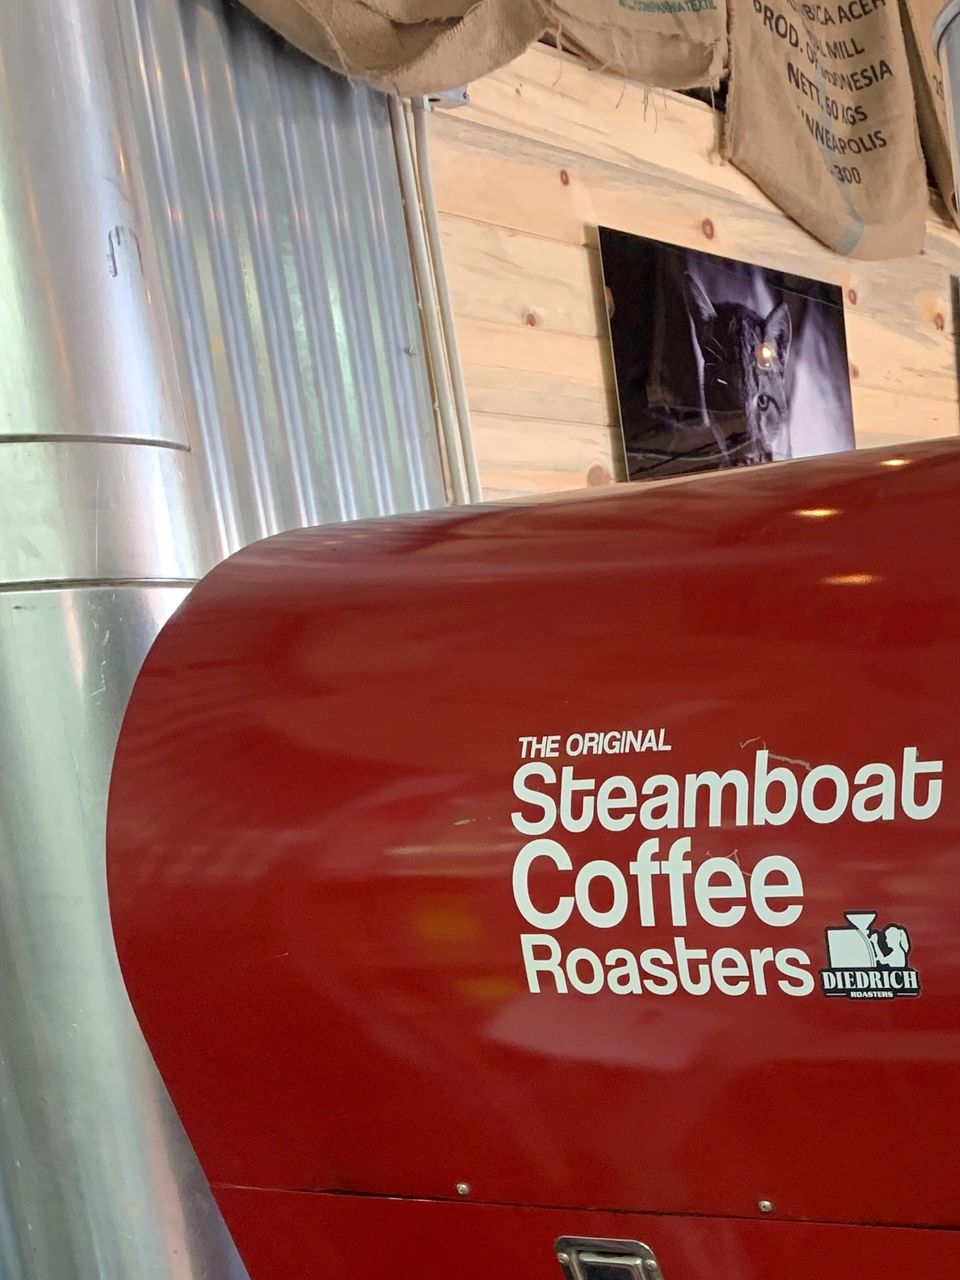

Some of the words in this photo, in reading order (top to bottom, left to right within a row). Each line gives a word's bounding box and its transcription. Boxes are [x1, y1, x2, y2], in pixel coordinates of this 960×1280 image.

[827, 37, 865, 61] MILL
[518, 736, 561, 759] THE
[565, 728, 672, 758] ORIGINAL
[511, 747, 943, 836] Steamboat
[512, 836, 804, 930] Coffee
[520, 934, 815, 996] Roasters
[822, 970, 919, 989] DIEDRICH
